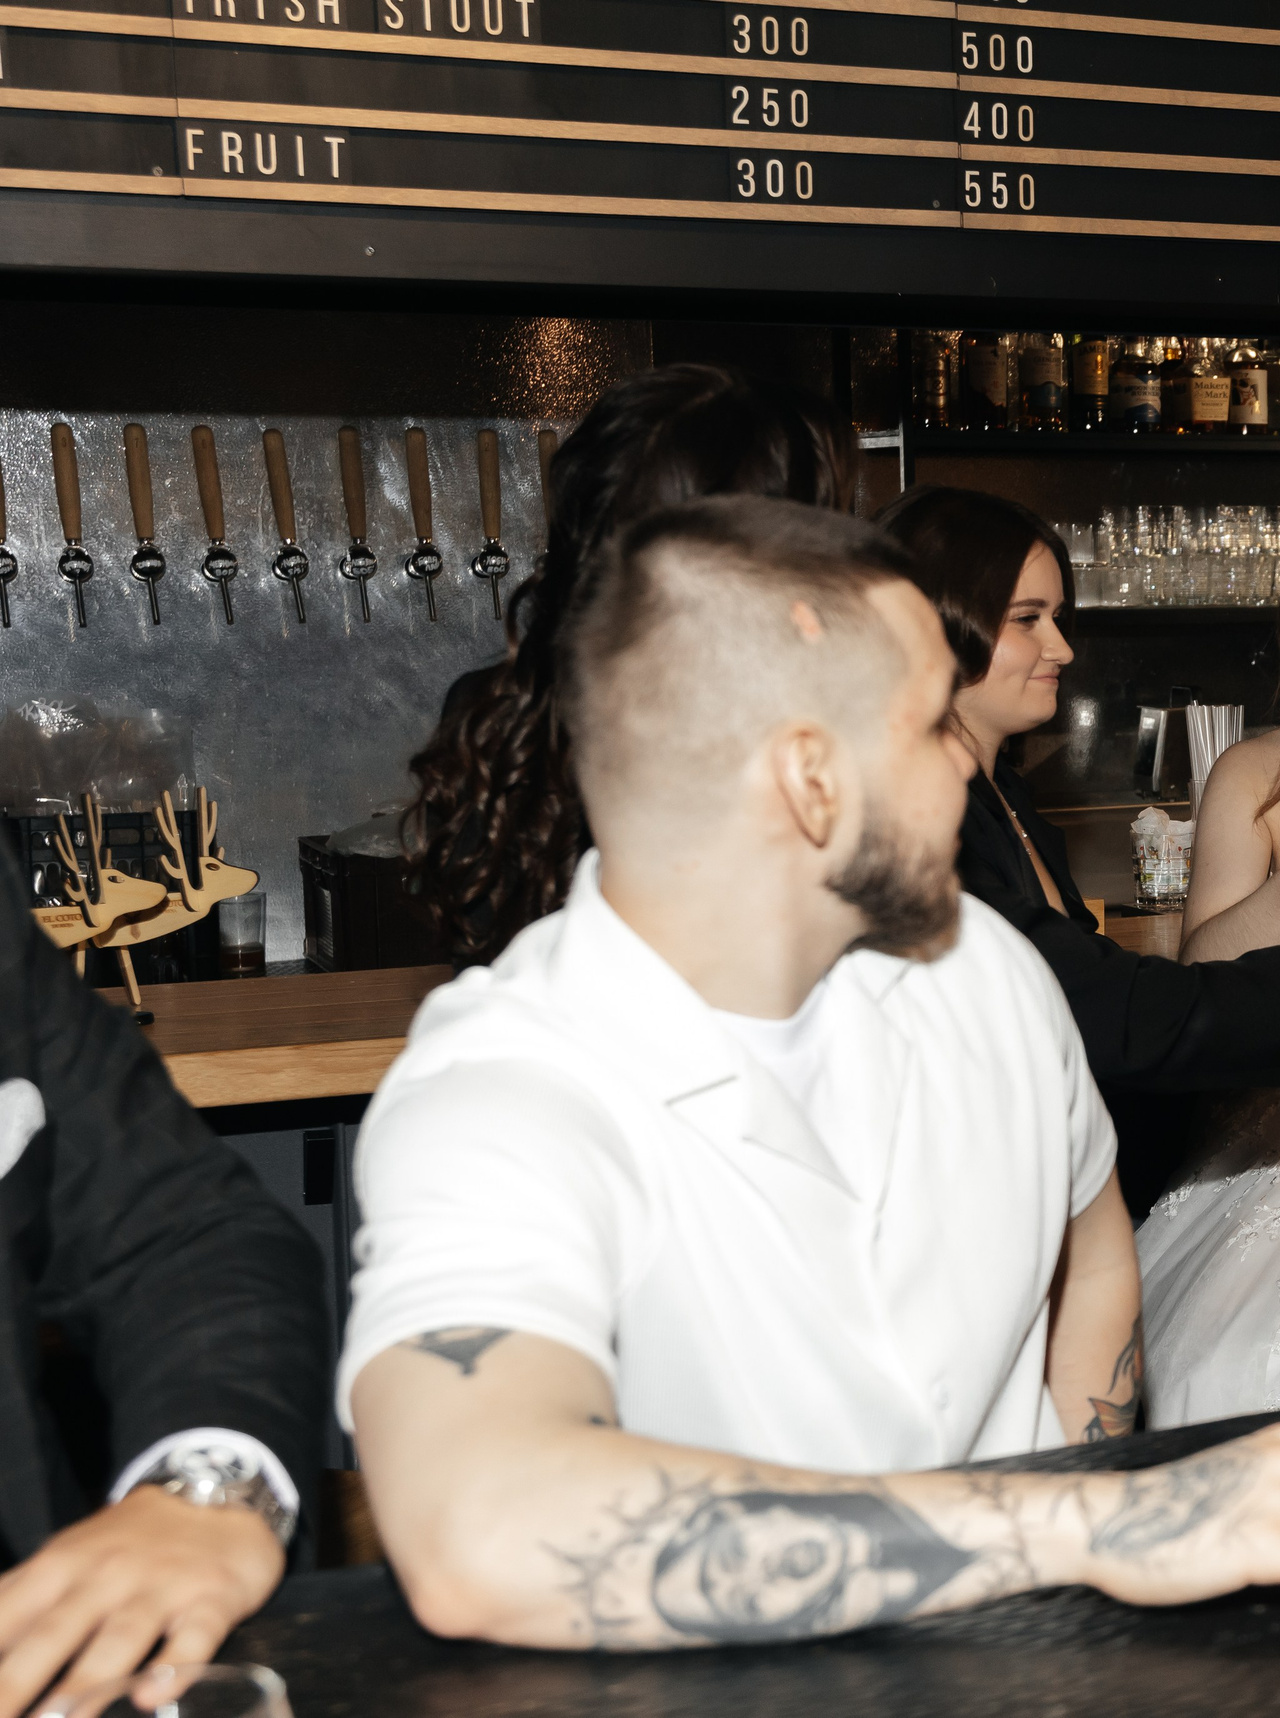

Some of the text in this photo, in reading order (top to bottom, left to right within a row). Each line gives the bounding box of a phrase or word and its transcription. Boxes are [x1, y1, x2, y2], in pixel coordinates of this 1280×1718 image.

[185, 0, 341, 25] ISH
[733, 14, 809, 56] 300
[962, 31, 1033, 73] 500
[731, 85, 1034, 142] 250 400
[185, 128, 1035, 211] FRUIT 300 550
[1205, 390, 1228, 399] Mark
[55, 913, 83, 922] COTO
